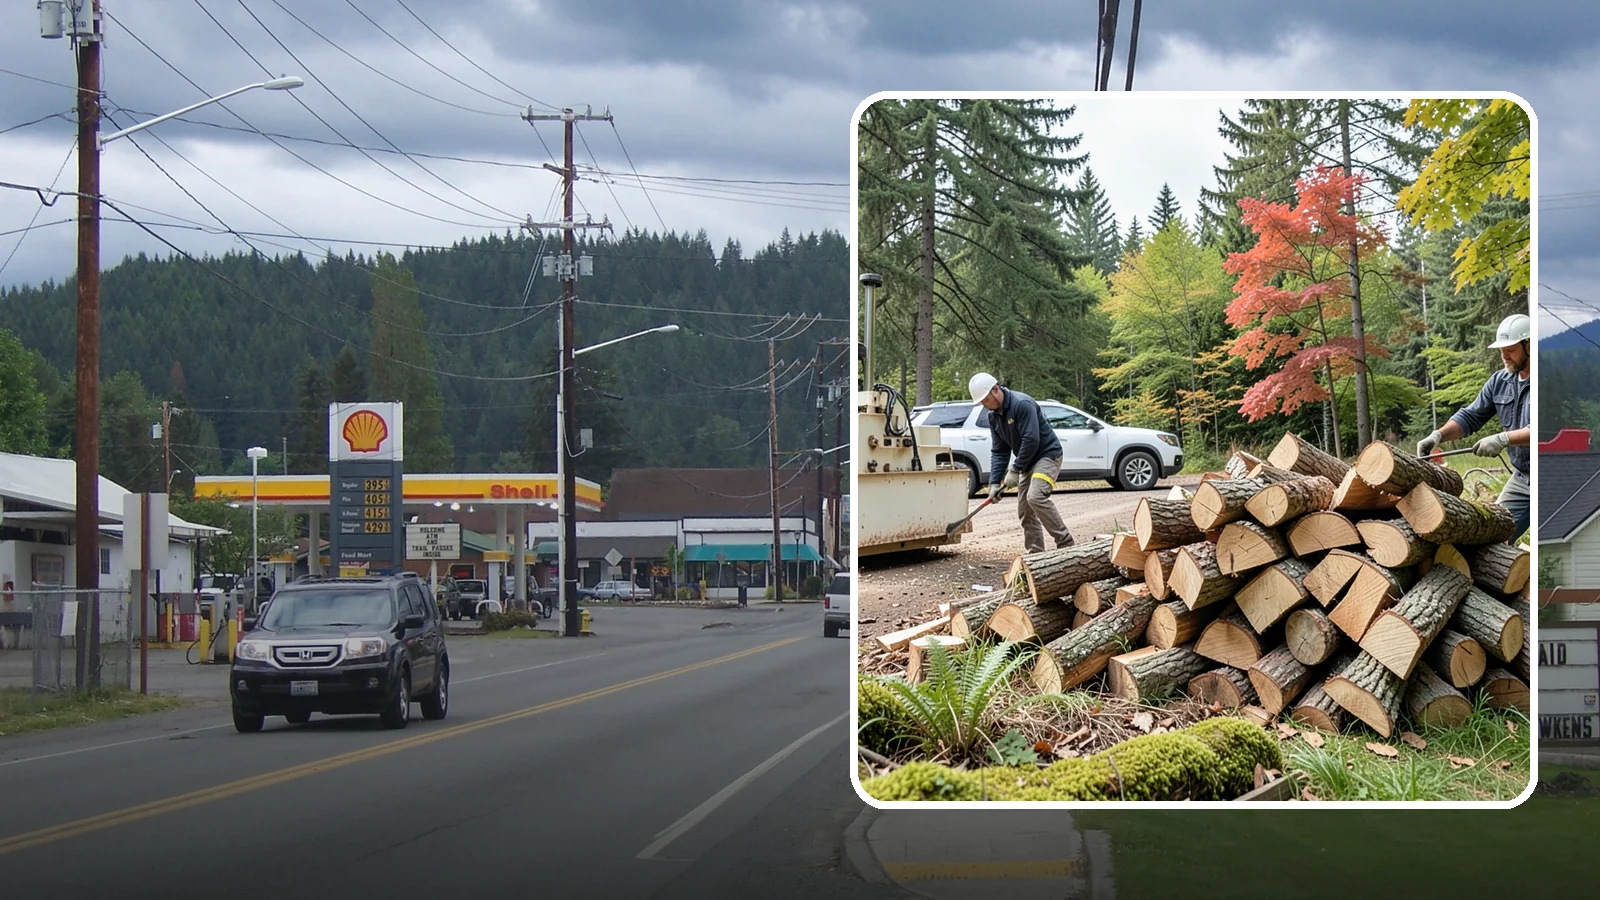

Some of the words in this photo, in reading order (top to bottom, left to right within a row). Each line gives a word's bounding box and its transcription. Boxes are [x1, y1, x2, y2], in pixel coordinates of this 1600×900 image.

[365, 480, 384, 490] 395
[490, 484, 547, 498] Shell
[365, 494, 384, 504] 405
[365, 507, 383, 518] 415
[365, 522, 383, 532] 429
